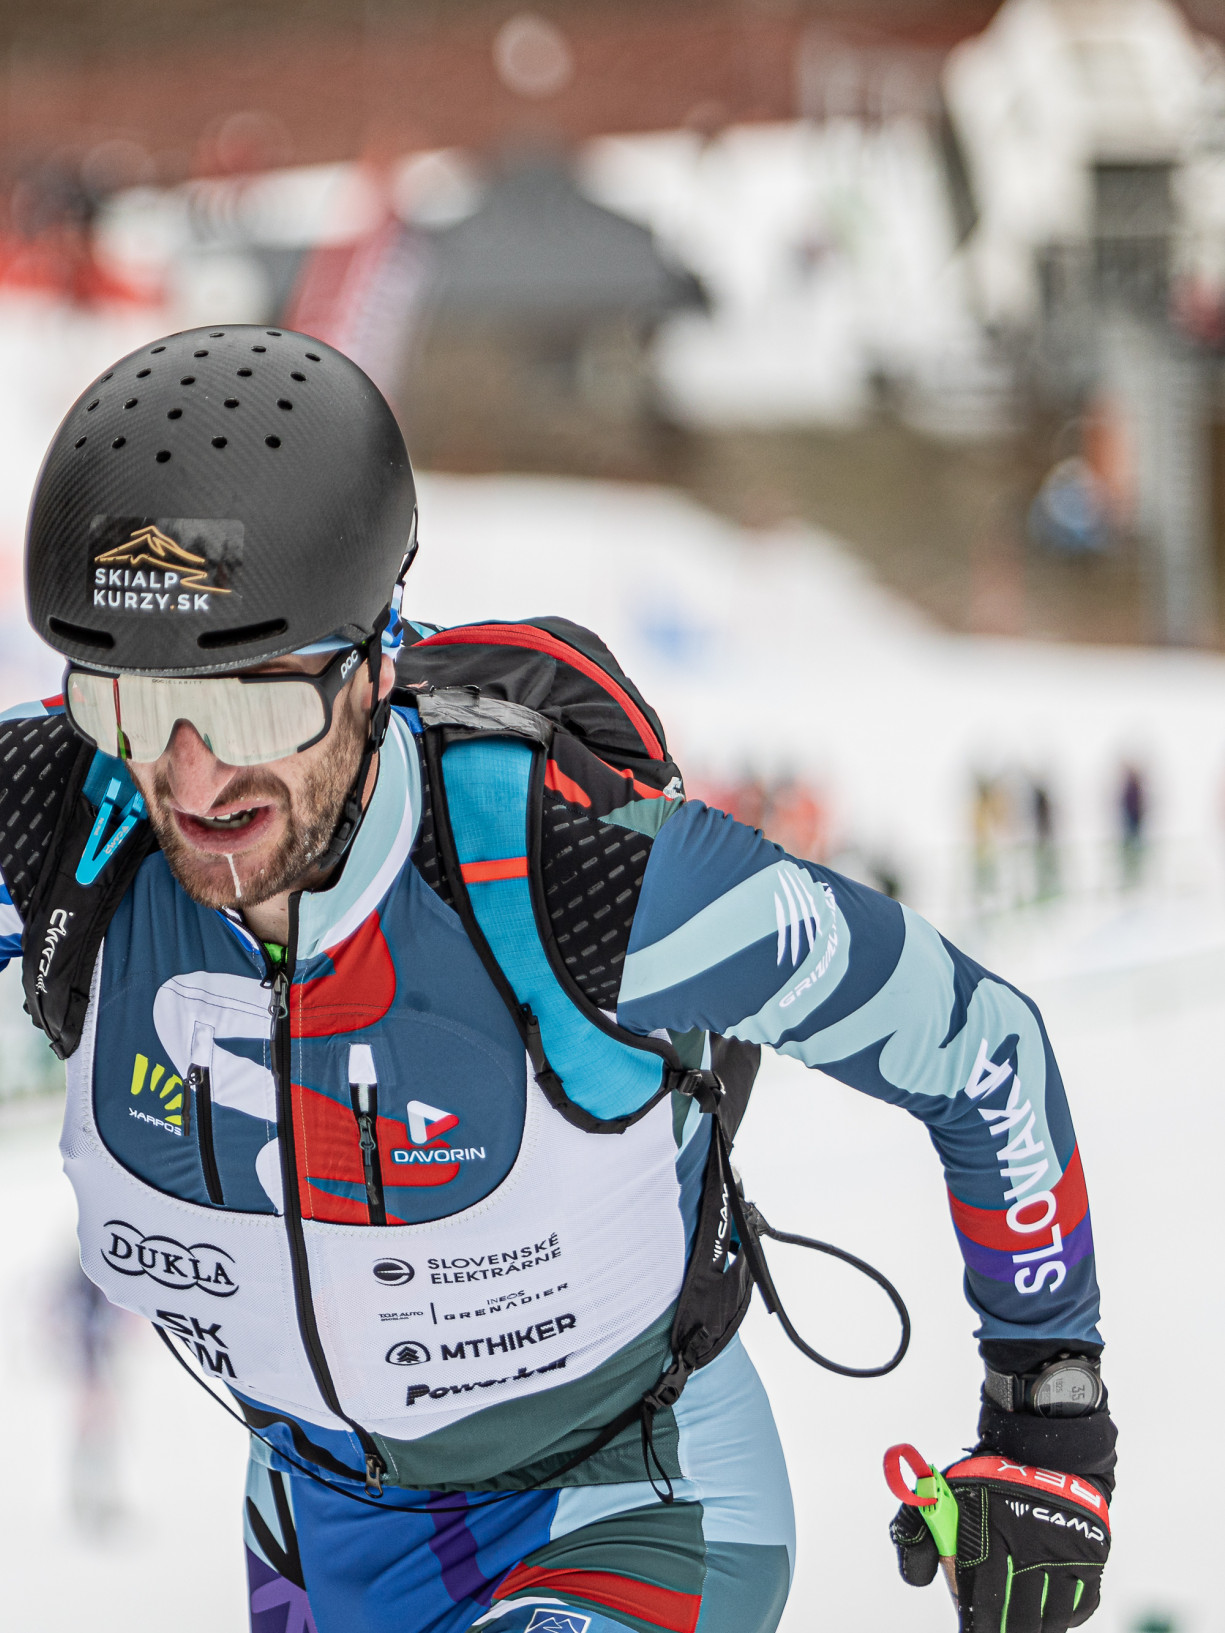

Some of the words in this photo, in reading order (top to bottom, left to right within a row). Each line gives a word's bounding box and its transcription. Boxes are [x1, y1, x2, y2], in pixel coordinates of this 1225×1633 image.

[94, 567, 179, 587] SKIALP
[93, 589, 210, 611] KURZY.SK
[128, 1106, 182, 1137] KARPOS
[393, 1145, 487, 1165] DAVORIN
[108, 1232, 235, 1286] DUKLA
[427, 1232, 559, 1270] SLOVENSKÉ
[430, 1246, 562, 1285] ELEKTRÁRNE
[443, 1282, 569, 1321] GRENADIER
[486, 1289, 526, 1306] INEOS
[440, 1312, 577, 1361] MTHIKER
[1031, 1506, 1105, 1543] CAMP
